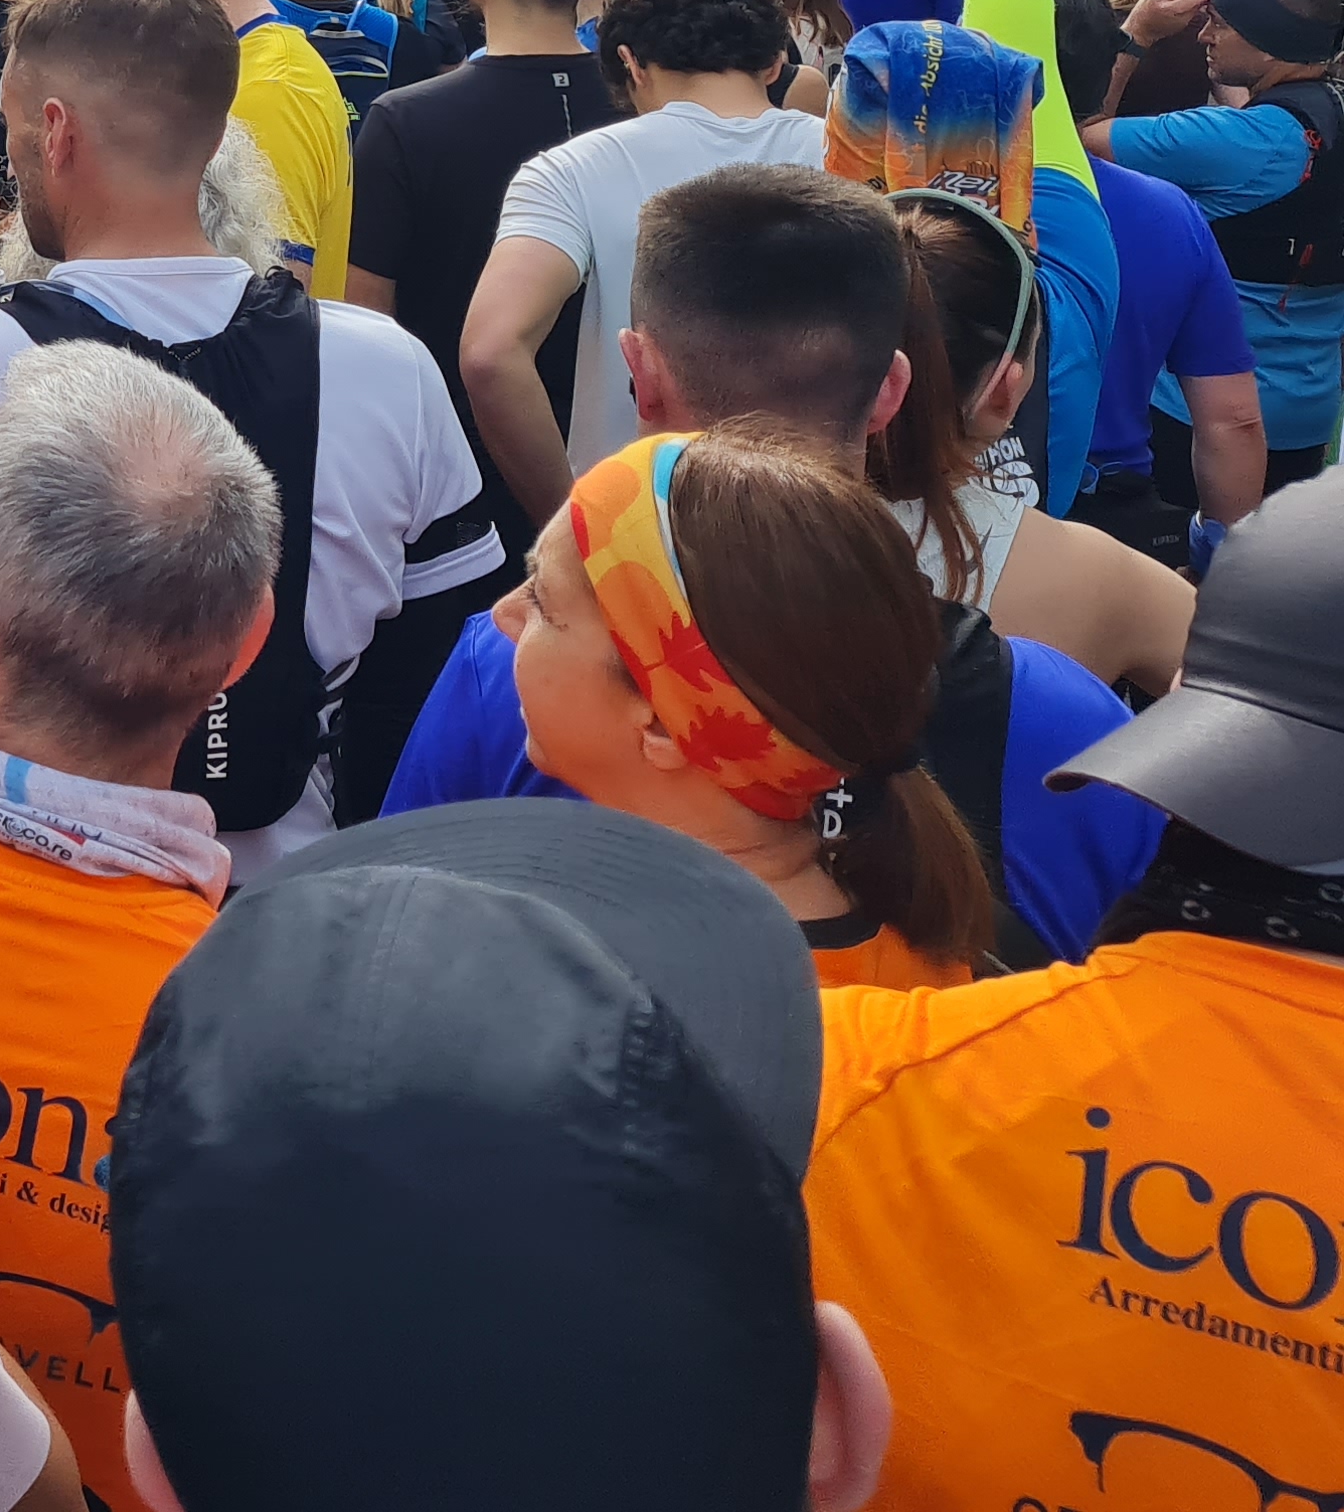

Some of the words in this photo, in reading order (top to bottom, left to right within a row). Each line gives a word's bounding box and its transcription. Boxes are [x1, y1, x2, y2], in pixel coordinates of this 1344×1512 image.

[16, 1179, 40, 1206] &
[1055, 1106, 1344, 1313] ico
[0, 1338, 122, 1394] VELL
